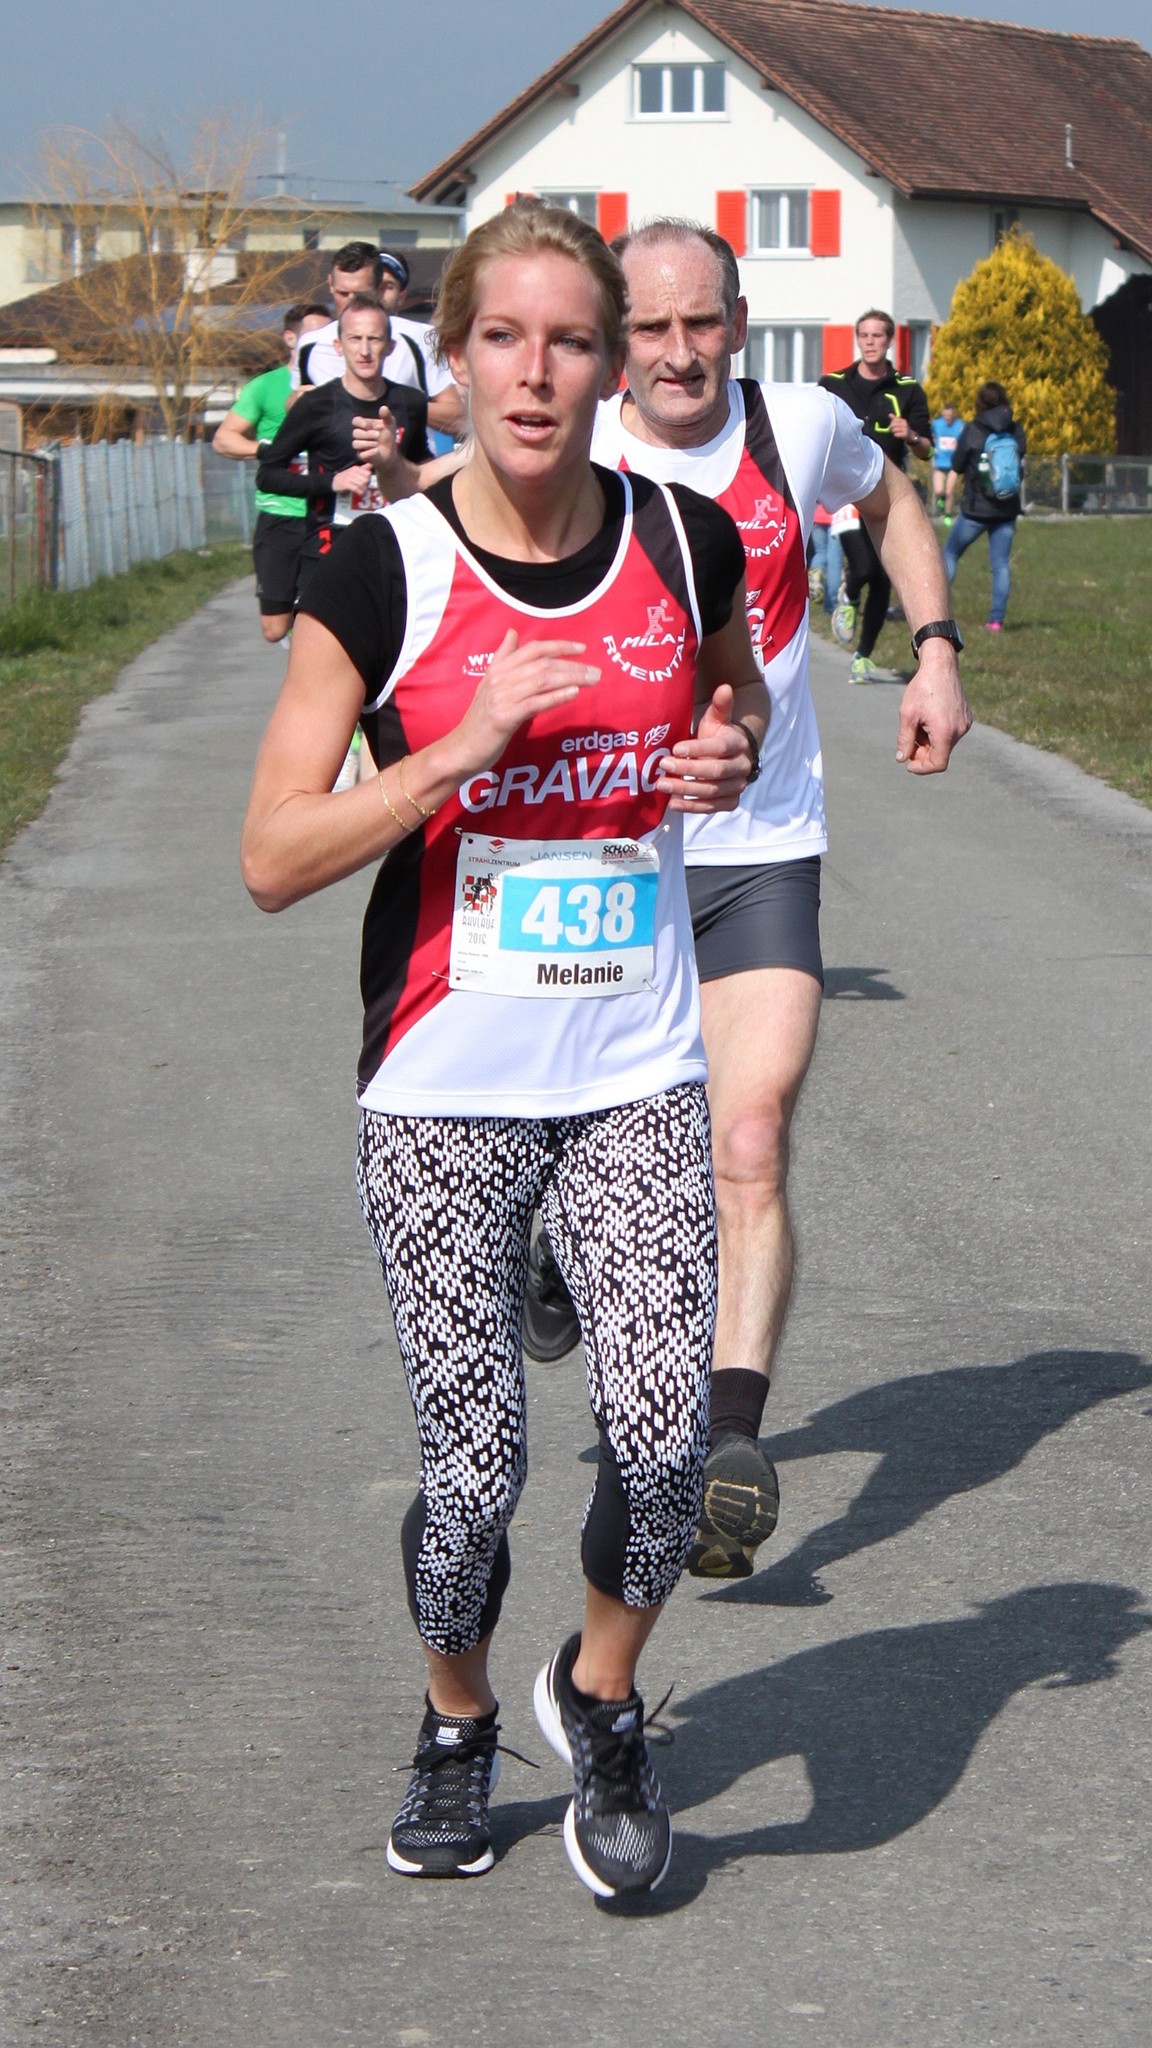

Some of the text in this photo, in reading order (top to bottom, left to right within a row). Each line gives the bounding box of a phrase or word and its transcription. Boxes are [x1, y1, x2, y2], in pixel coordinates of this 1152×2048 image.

[602, 627, 686, 682] RHEINTAL
[561, 730, 639, 753] erdgas
[530, 851, 593, 861] JANSEN
[602, 843, 640, 855] SCHLOSS
[468, 856, 521, 867] STRAHLZENTRUM
[521, 881, 637, 946] 438
[468, 931, 487, 945] 2016
[536, 961, 624, 985] Melanie
